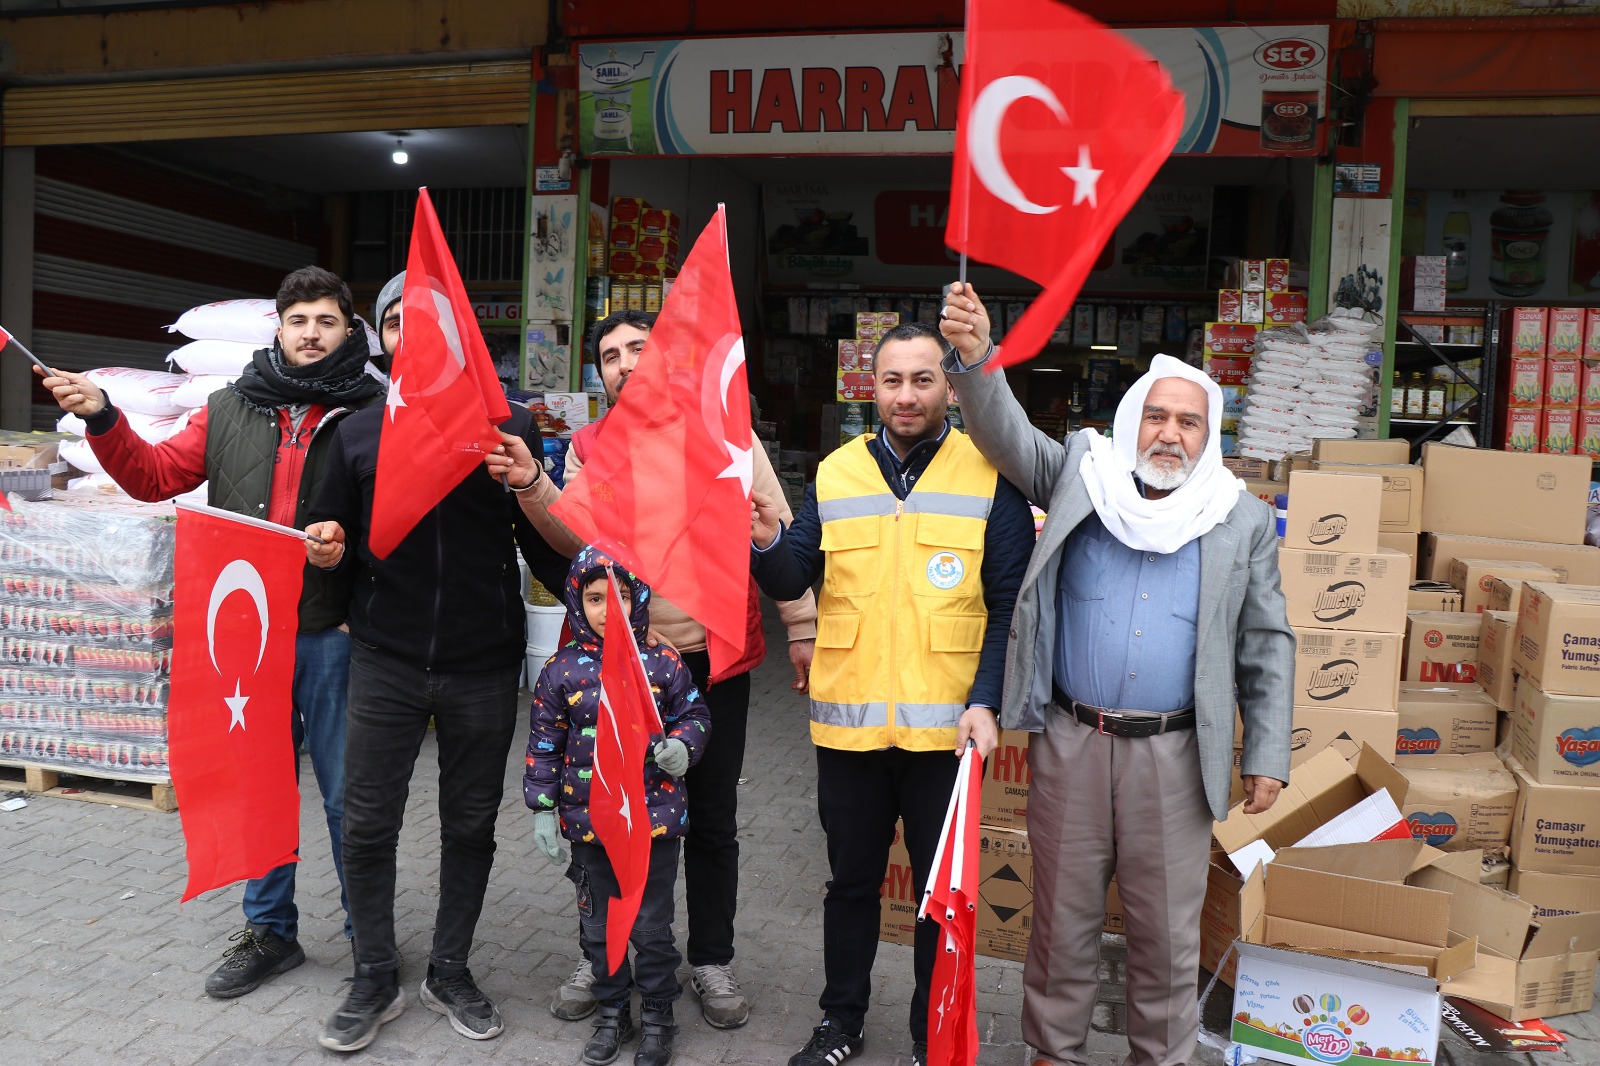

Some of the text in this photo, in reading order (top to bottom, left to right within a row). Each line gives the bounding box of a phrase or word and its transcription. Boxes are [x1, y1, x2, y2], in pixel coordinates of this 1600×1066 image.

[1266, 47, 1310, 65] SEÇ
[1259, 72, 1290, 84] Domates
[1279, 105, 1302, 116] SEÇ
[1555, 313, 1580, 321] SUNAR
[1515, 363, 1539, 371] SUNAR
[1552, 364, 1576, 372] SUNAR
[1512, 413, 1536, 421] SUNAR
[1307, 519, 1347, 537] Domestos
[1312, 588, 1365, 613] Domestos
[1561, 649, 1600, 665] Yumuş
[1306, 667, 1360, 692] Domestos
[1556, 735, 1600, 756] Yaşa
[1580, 770, 1600, 778] ÜRÜNL
[1536, 818, 1585, 833] Çamaşır
[1240, 973, 1260, 987] Elma
[1398, 1014, 1421, 1035] Tatlar
[1405, 1008, 1430, 1032] Süpriz
[1306, 1033, 1333, 1047] Meri
